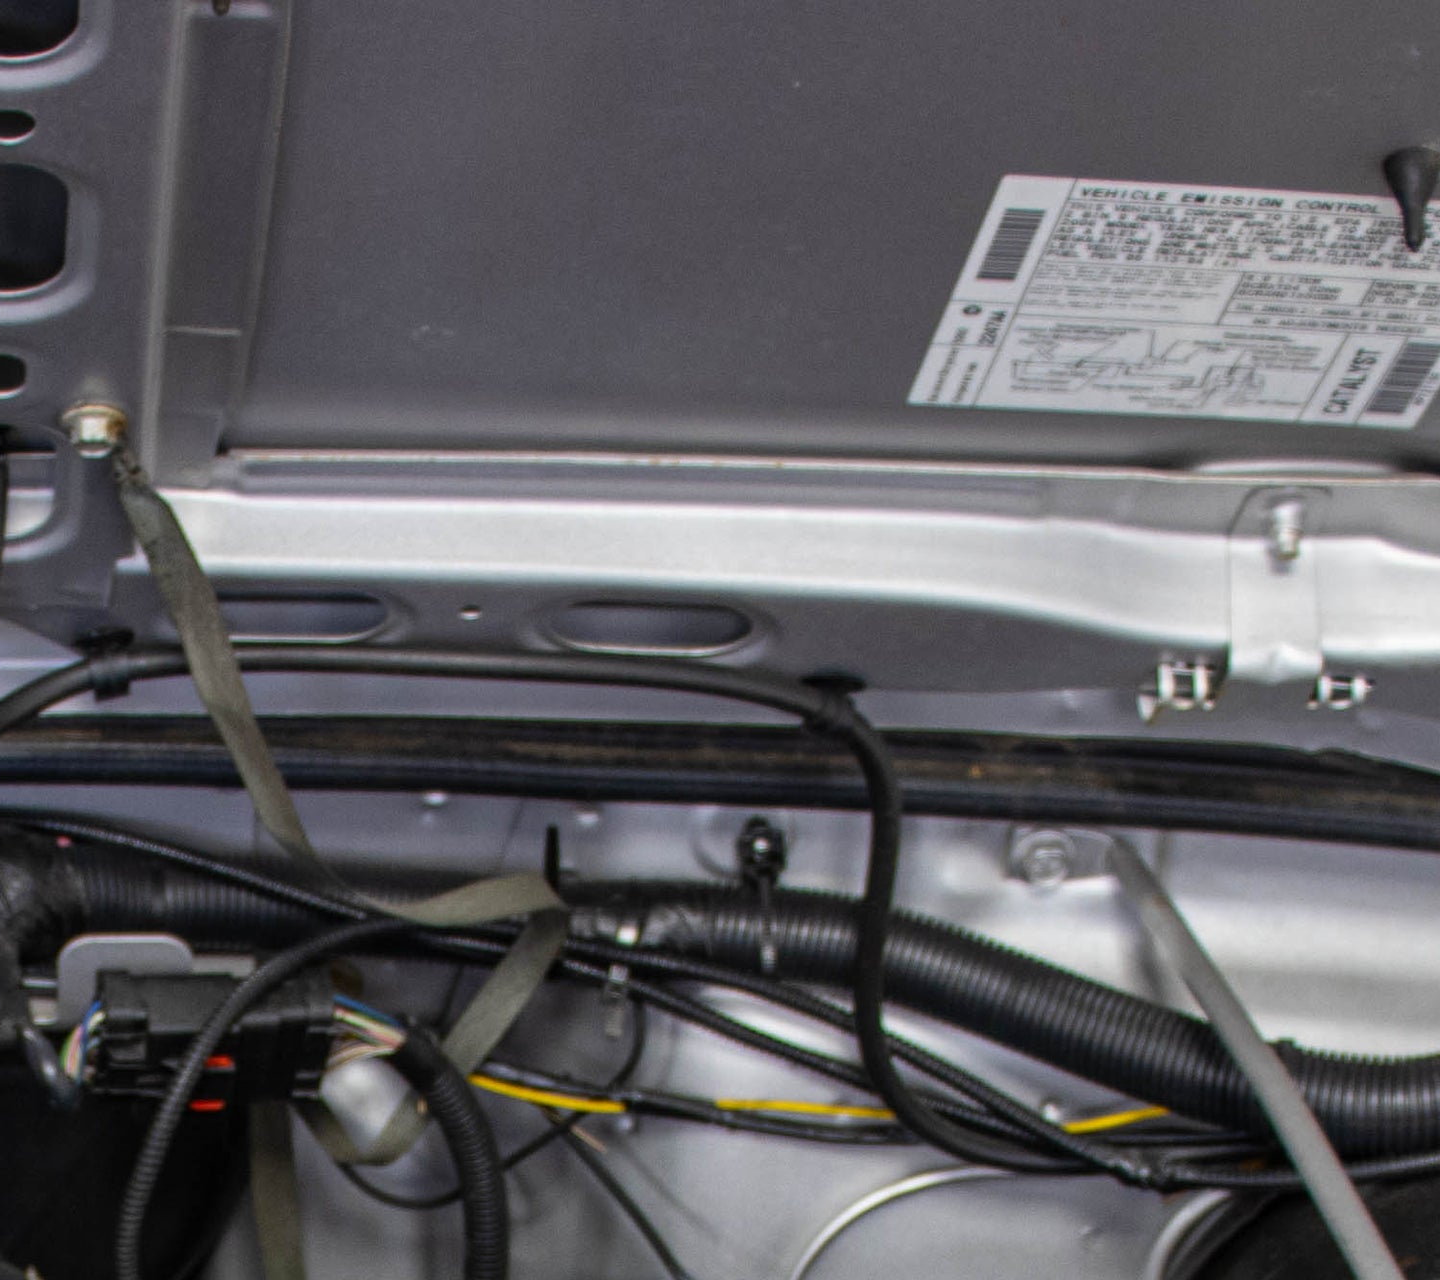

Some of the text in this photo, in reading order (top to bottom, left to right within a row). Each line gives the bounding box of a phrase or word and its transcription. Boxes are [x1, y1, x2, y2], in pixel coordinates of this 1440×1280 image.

[1081, 187, 1169, 202] VEHICLE
[1180, 192, 1284, 208] EMISSION
[1295, 199, 1382, 215] CONTROL
[1323, 347, 1382, 414] CATALYST
